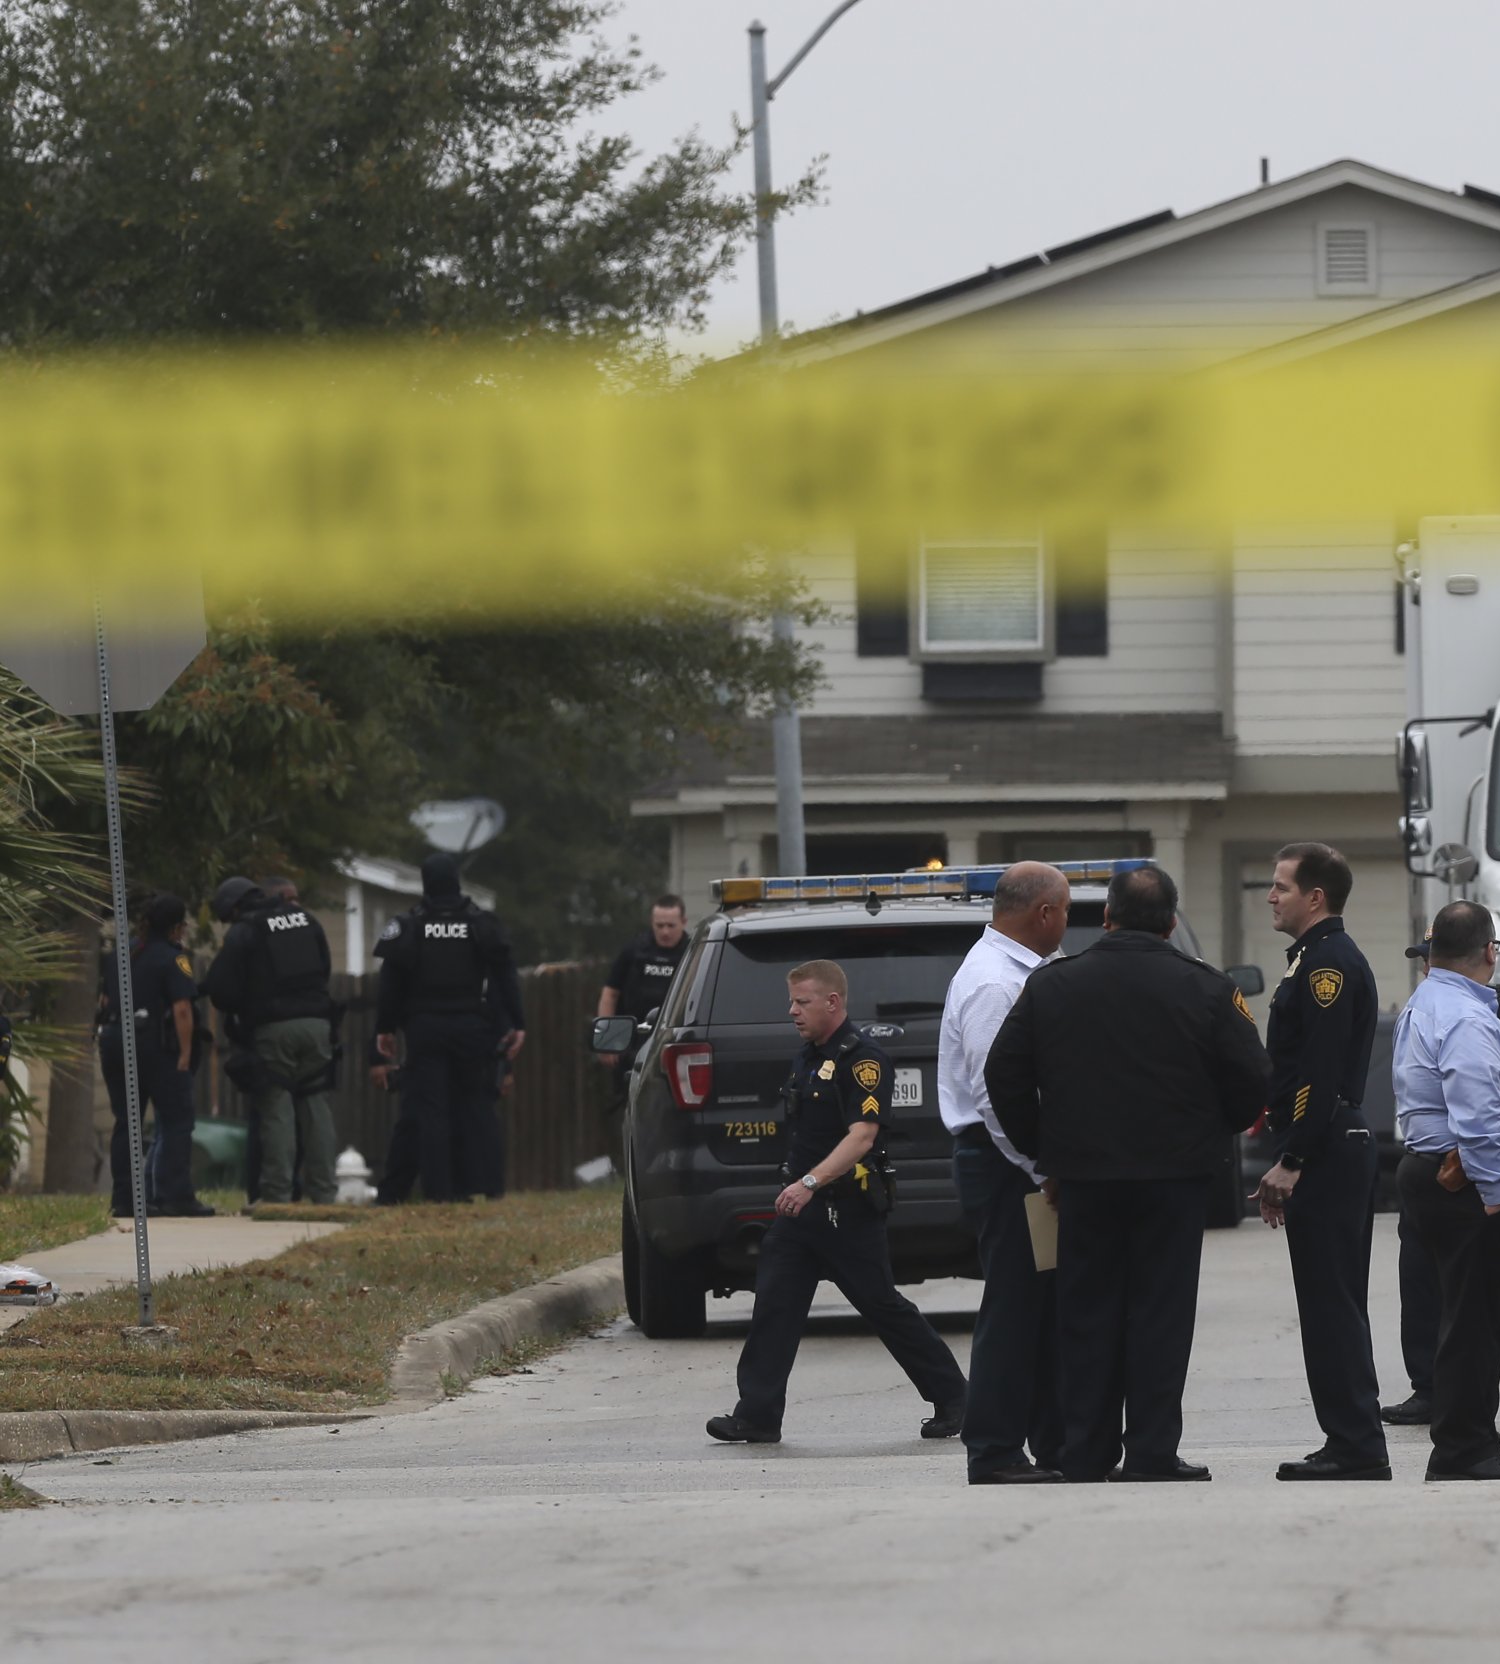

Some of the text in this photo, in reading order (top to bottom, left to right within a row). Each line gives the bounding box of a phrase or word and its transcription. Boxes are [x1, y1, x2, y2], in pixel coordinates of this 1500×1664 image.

[267, 912, 309, 932] POLICE
[425, 923, 467, 938] POLICE
[869, 1025, 895, 1037] Ford
[725, 1121, 776, 1136] 723116
